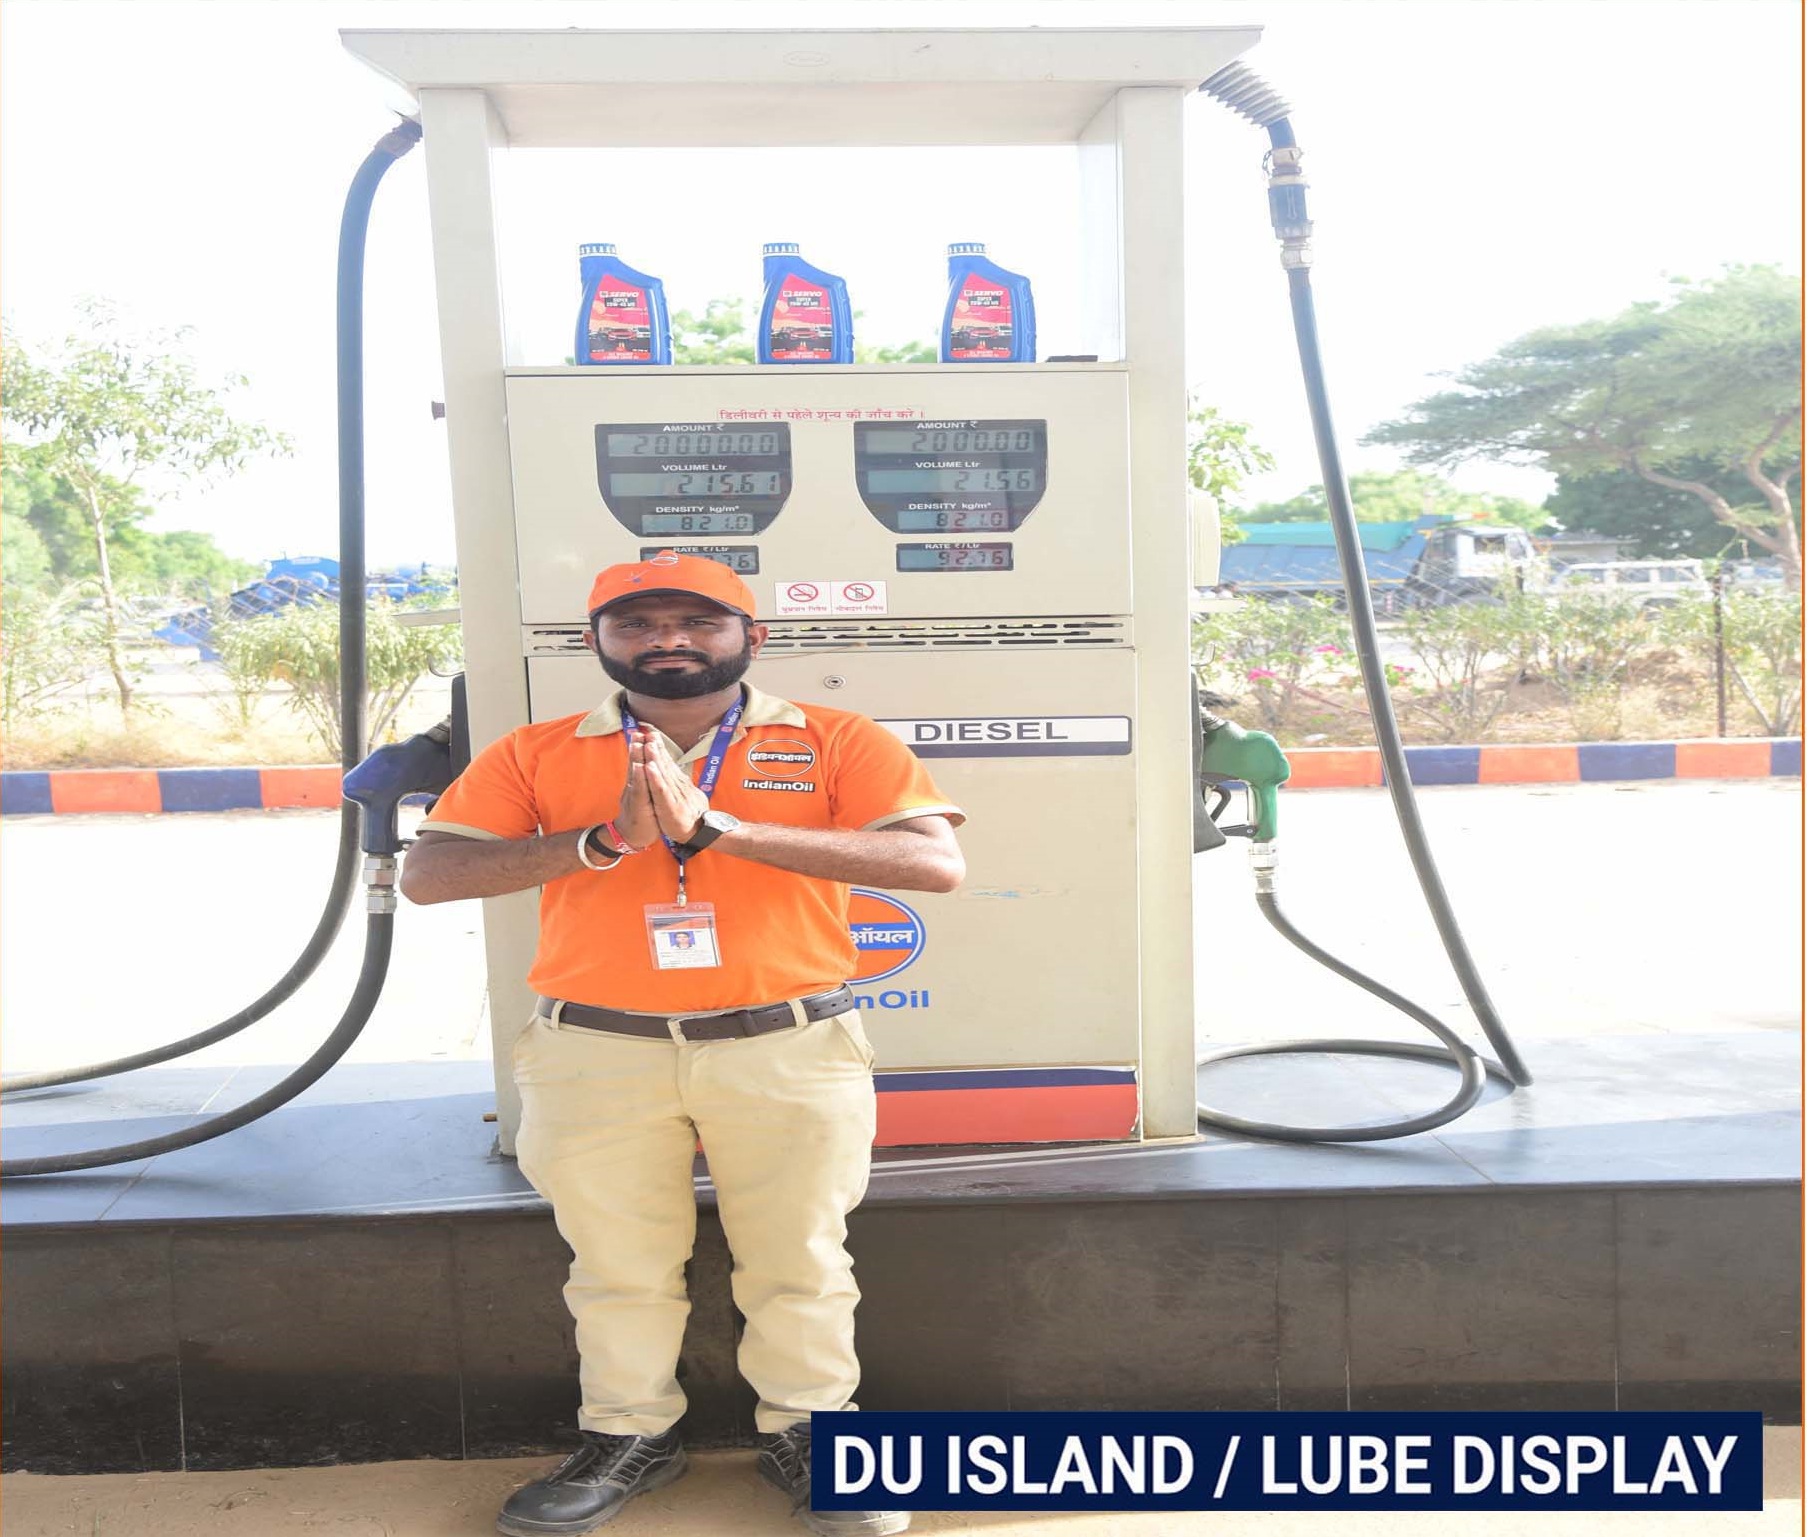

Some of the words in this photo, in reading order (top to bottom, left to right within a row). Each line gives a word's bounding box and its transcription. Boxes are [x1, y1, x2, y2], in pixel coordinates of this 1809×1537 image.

[719, 409, 767, 419] डिलीवरी
[771, 408, 782, 419] से
[816, 410, 841, 422] शून्य
[846, 408, 862, 419] की
[916, 421, 966, 429] AMOUNT
[633, 434, 775, 455] 20000.00
[912, 430, 1031, 451] 2000.00
[678, 475, 777, 494] 215.61
[954, 471, 1031, 490] 21.56
[681, 516, 748, 531] 821.0
[936, 513, 1002, 527] 821.0
[938, 551, 1004, 565] 92.76
[915, 722, 1068, 742] DIESEL
[710, 756, 720, 765] Oil
[704, 766, 717, 784] Indian
[744, 780, 814, 791] IndianOil
[850, 927, 914, 944] ऑयल
[854, 990, 929, 1009] nOil
